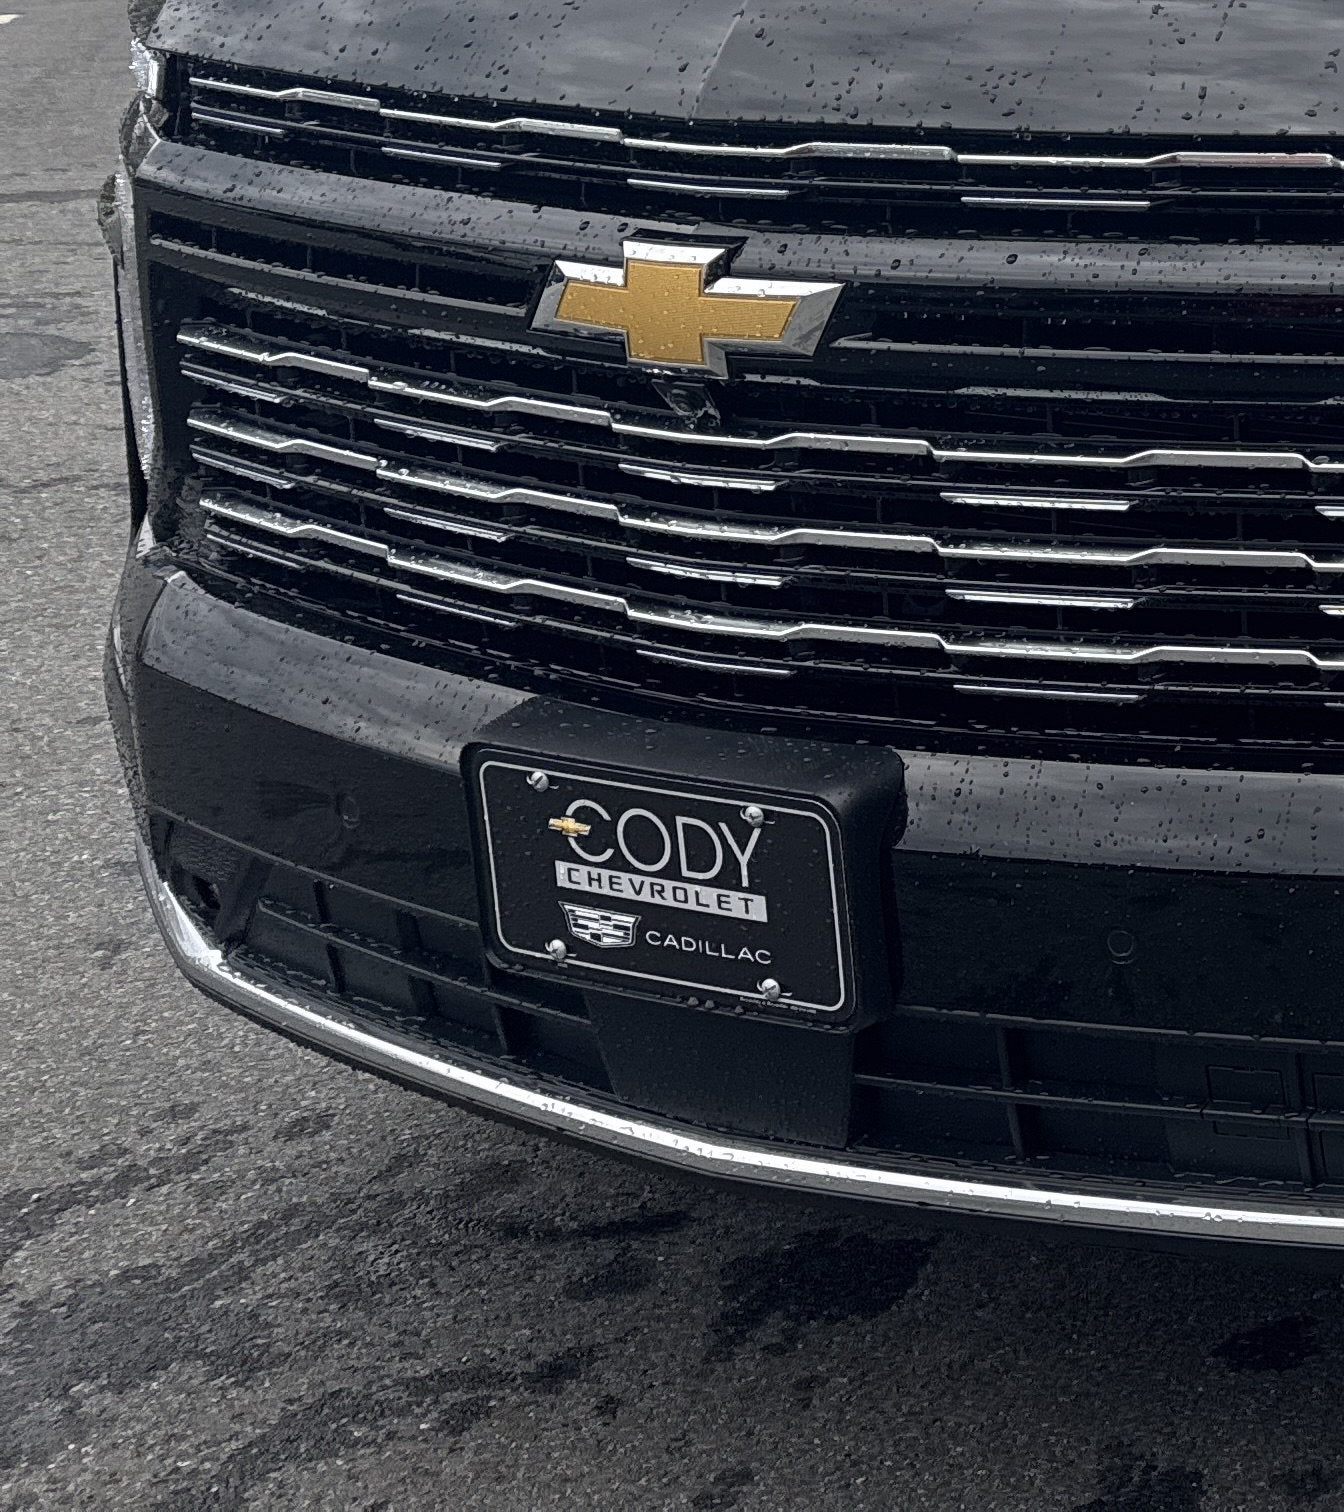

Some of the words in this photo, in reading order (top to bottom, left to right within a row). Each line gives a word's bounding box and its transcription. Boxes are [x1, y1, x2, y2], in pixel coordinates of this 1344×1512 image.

[565, 798, 761, 888] CODY
[566, 867, 756, 917] CHEVROLET
[645, 929, 773, 965] CADILLAC
